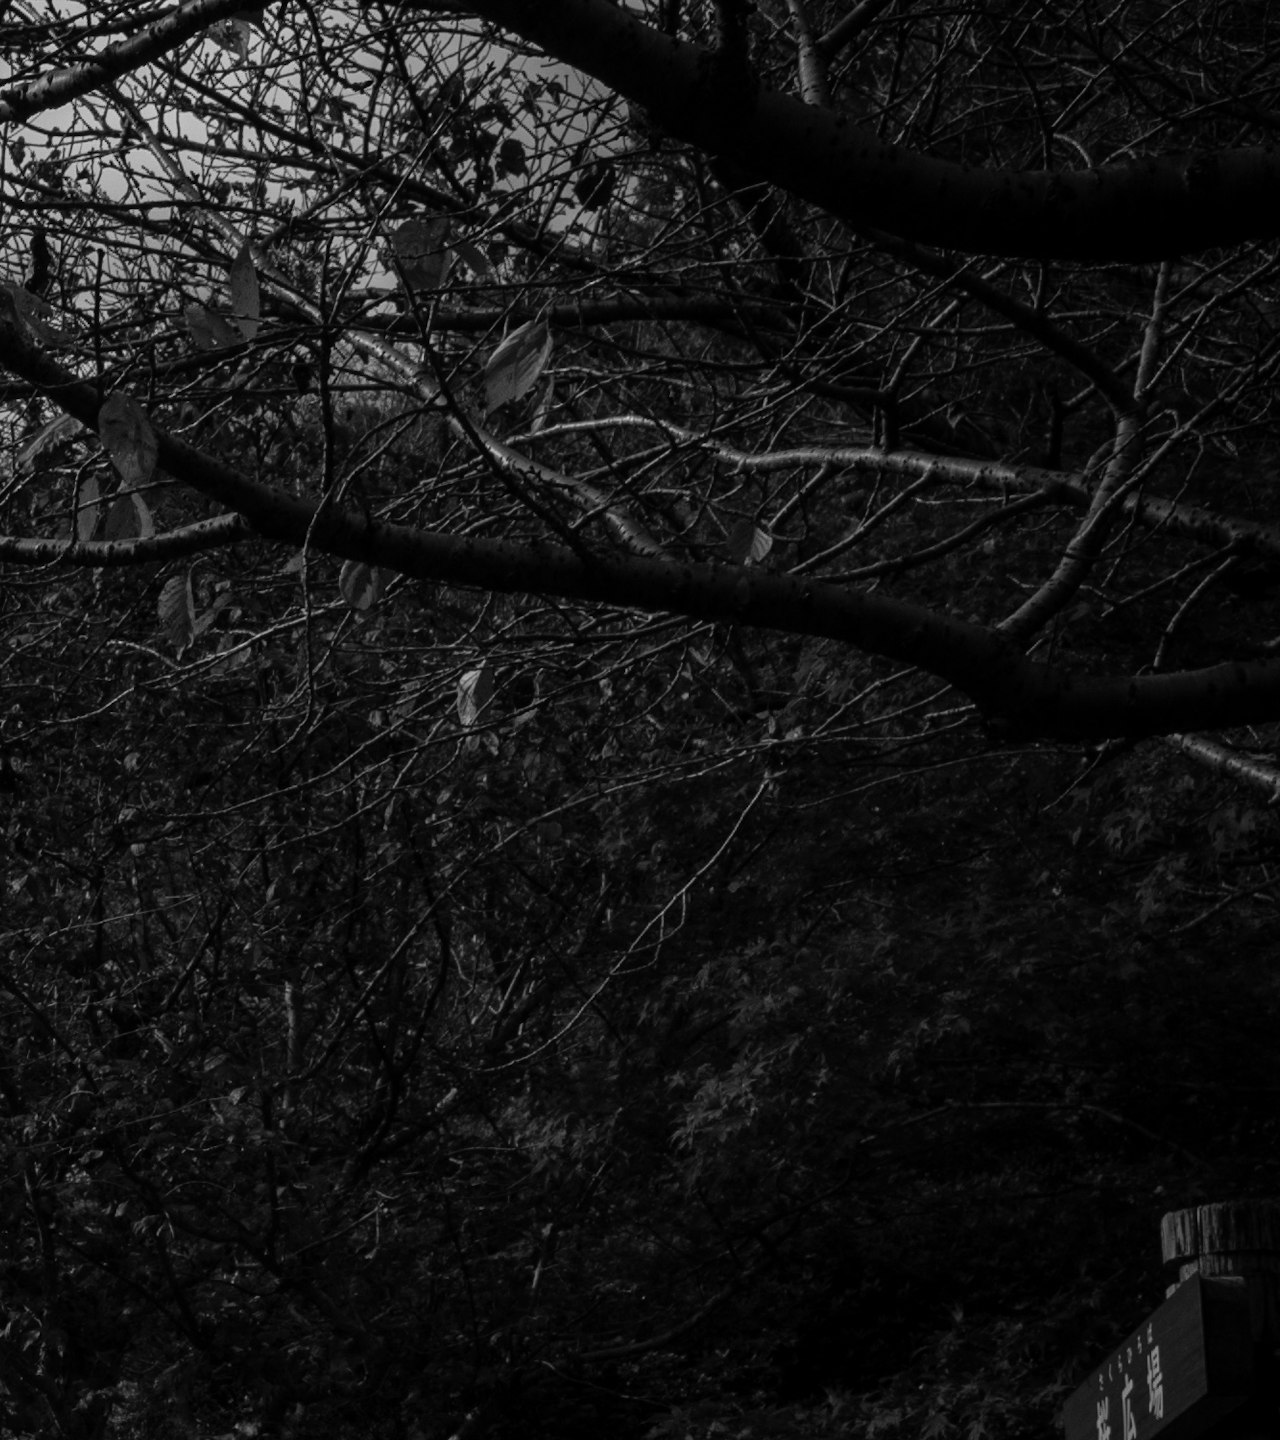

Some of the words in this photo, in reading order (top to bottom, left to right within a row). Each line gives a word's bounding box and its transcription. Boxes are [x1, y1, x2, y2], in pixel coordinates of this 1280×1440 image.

[1098, 1322, 1154, 1392] さくらひろば
